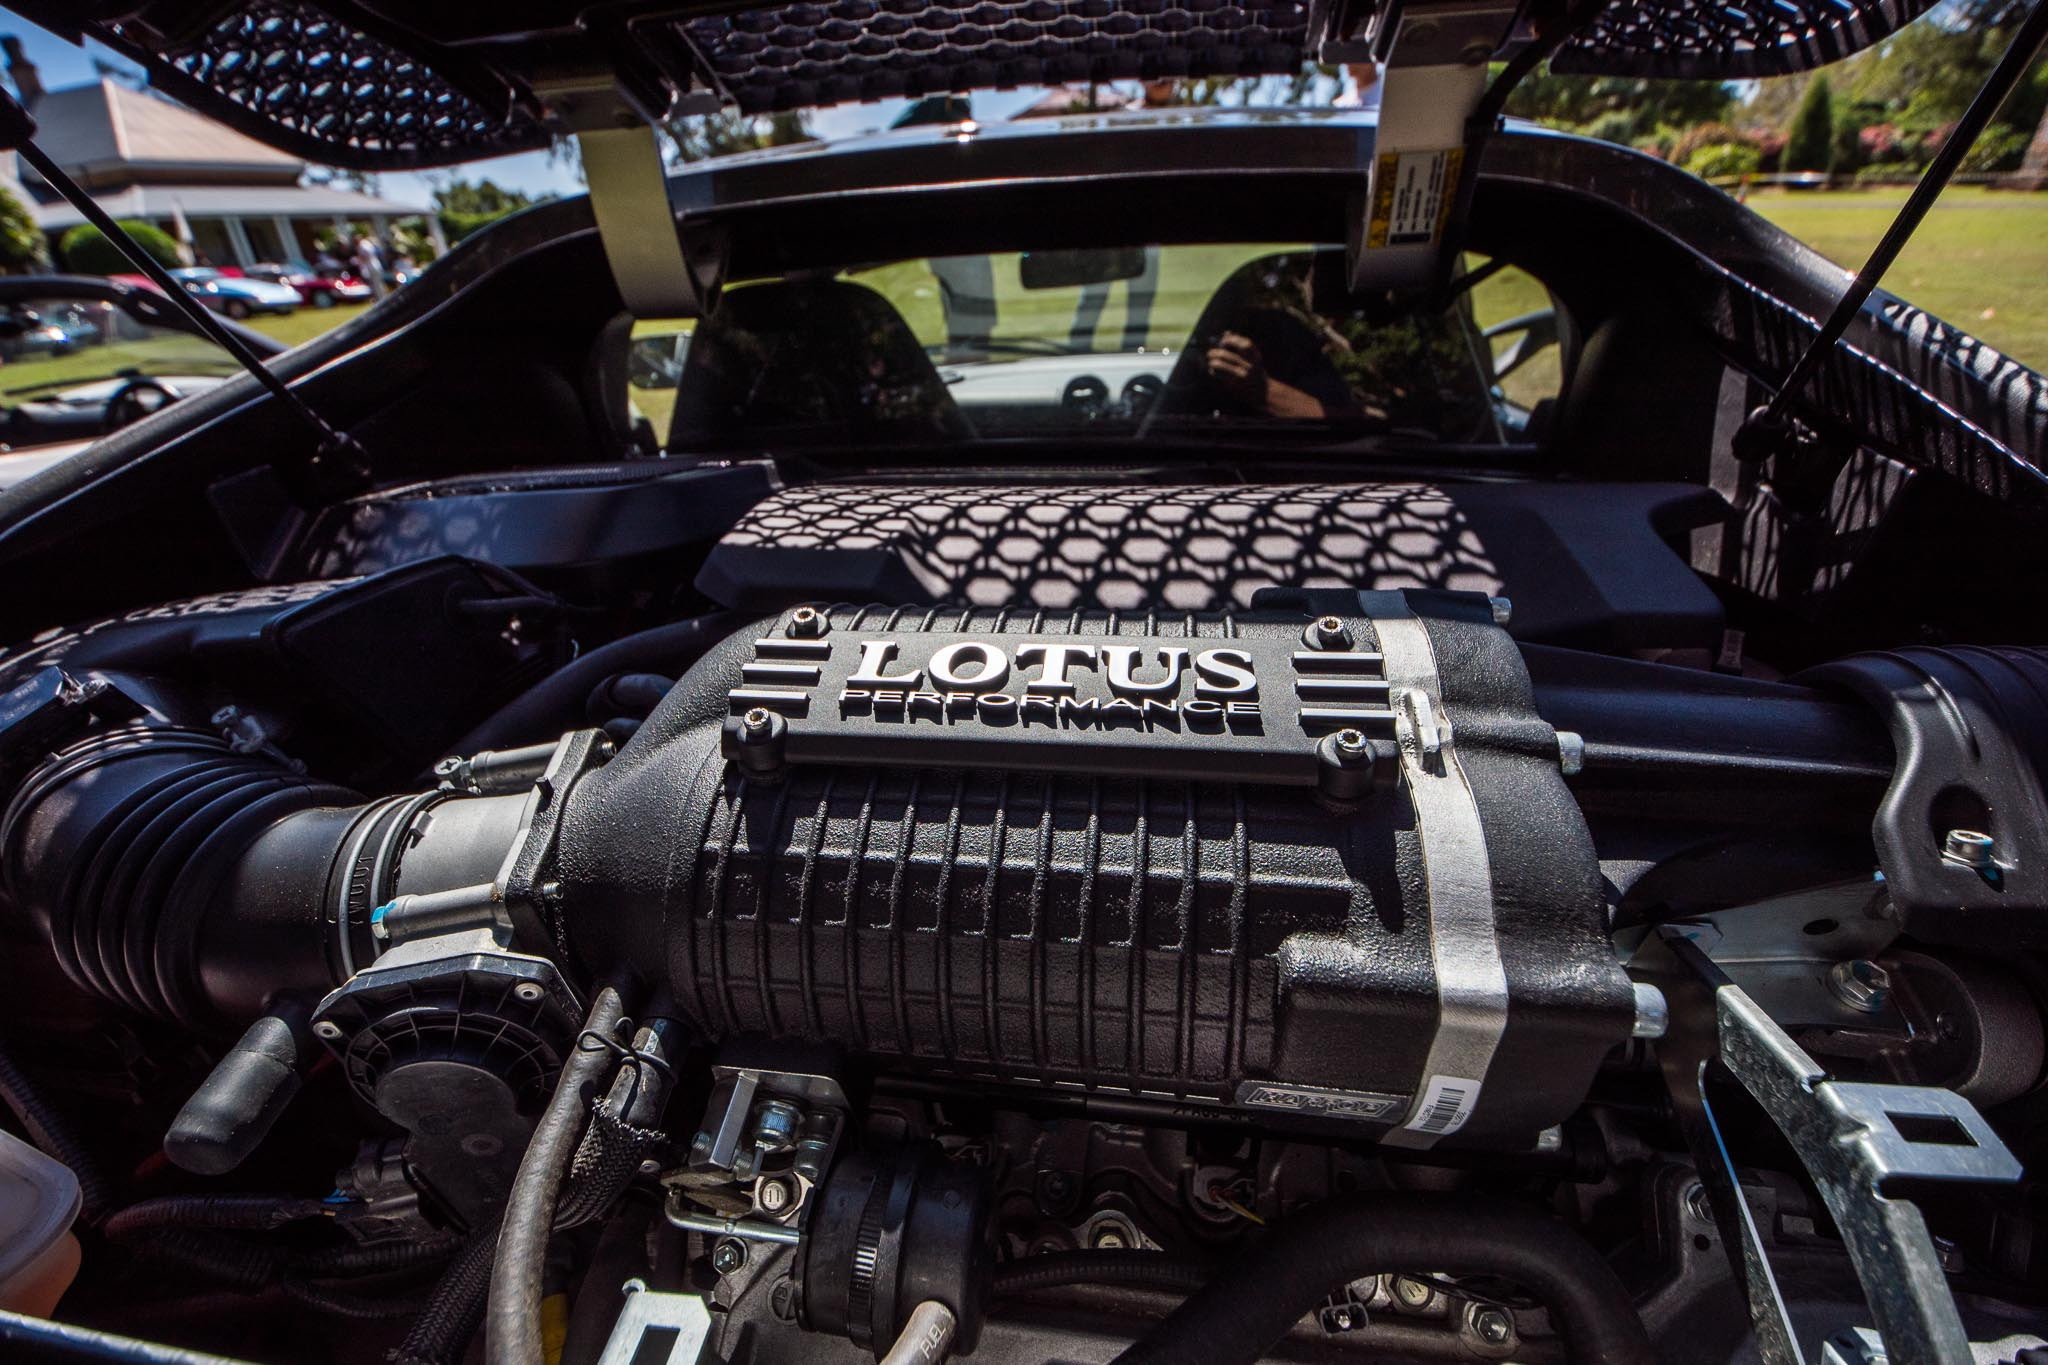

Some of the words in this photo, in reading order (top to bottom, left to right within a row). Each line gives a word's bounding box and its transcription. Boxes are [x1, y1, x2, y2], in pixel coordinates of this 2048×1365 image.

[846, 639, 1259, 695] LOTUS
[837, 688, 1262, 717] PERFORMANCE
[920, 1324, 947, 1360] FUEL
